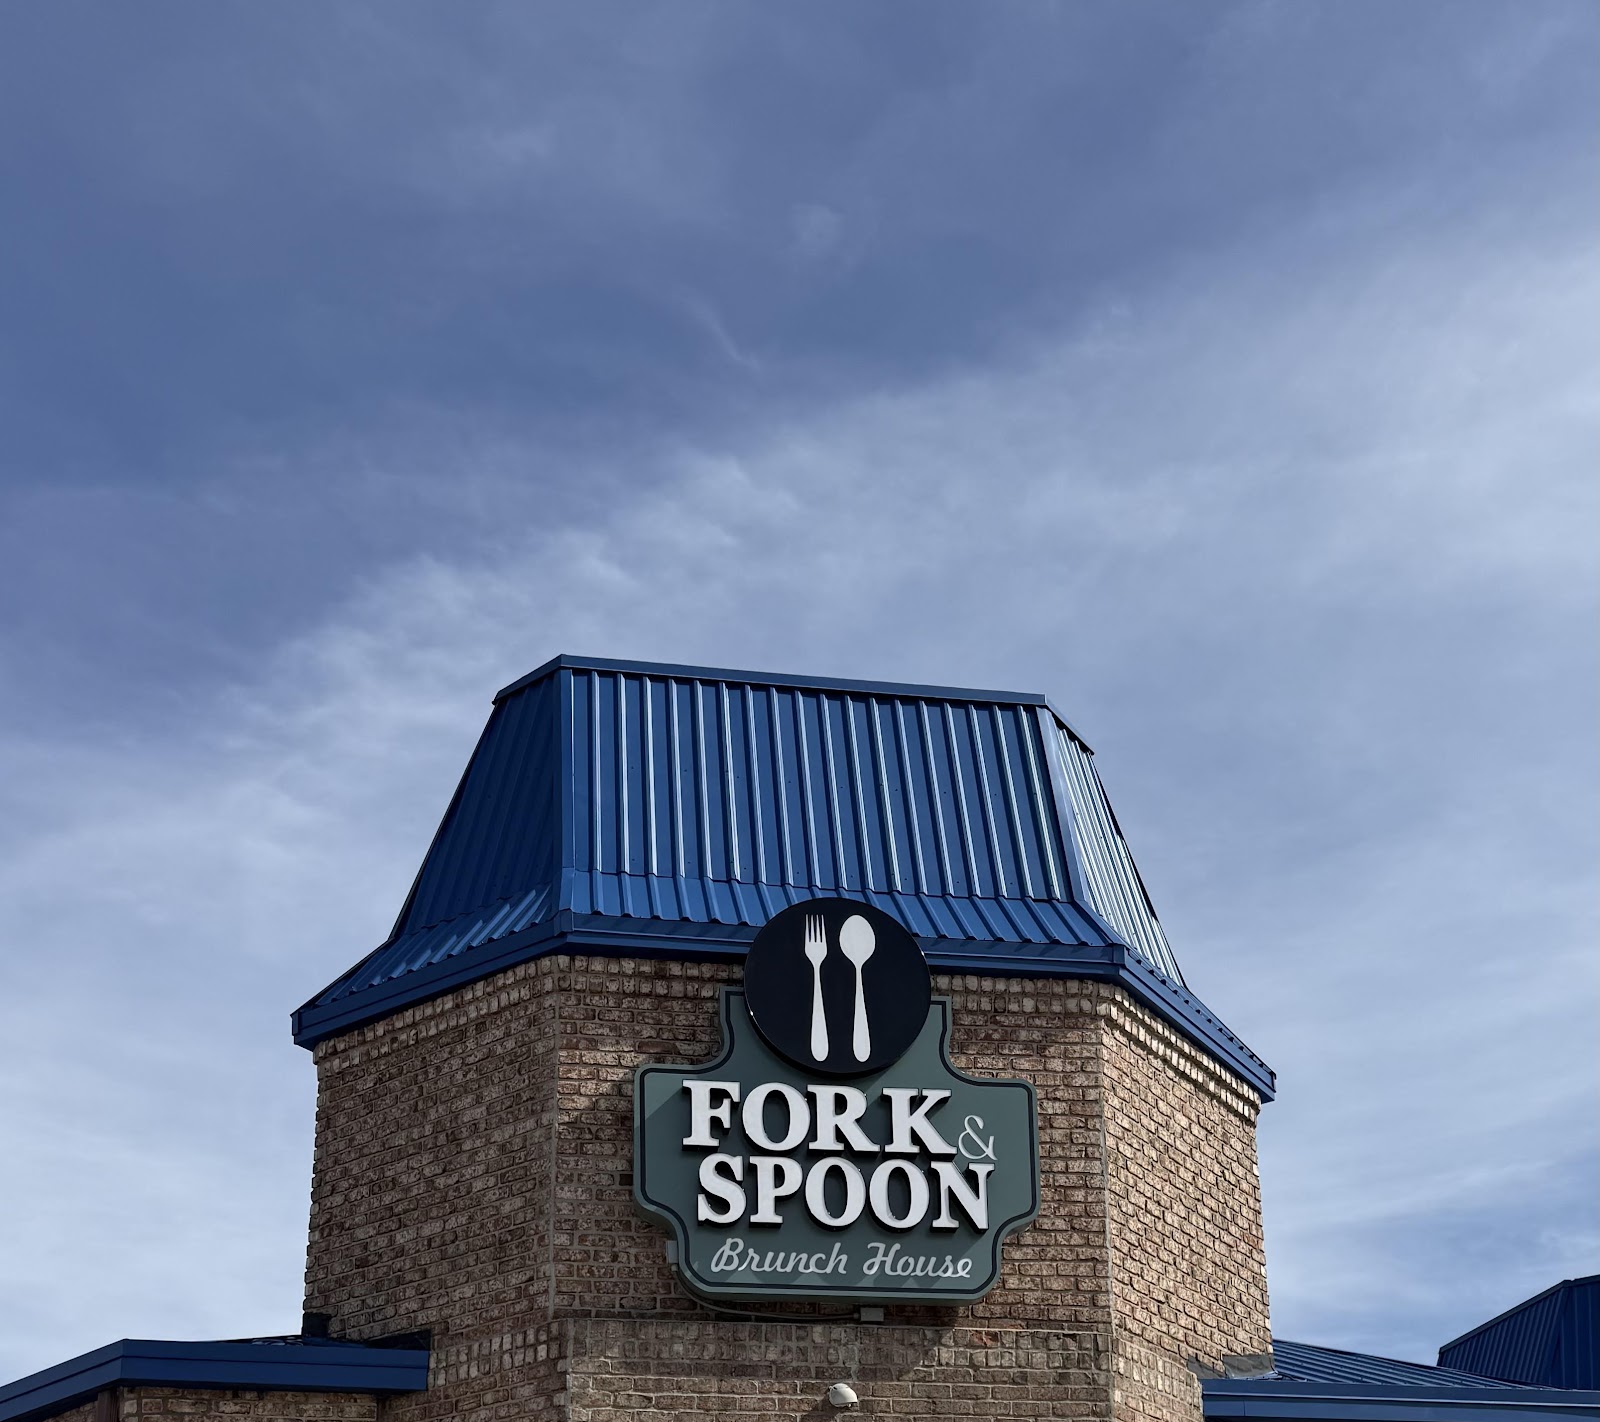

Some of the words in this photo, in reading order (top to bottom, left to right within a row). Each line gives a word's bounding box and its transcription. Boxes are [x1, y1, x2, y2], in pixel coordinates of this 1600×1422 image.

[682, 1079, 958, 1157] FORK
[958, 1114, 998, 1161] &
[697, 1152, 995, 1231] SPOON
[710, 1237, 847, 1275] Brunch
[862, 1241, 972, 1279] House
